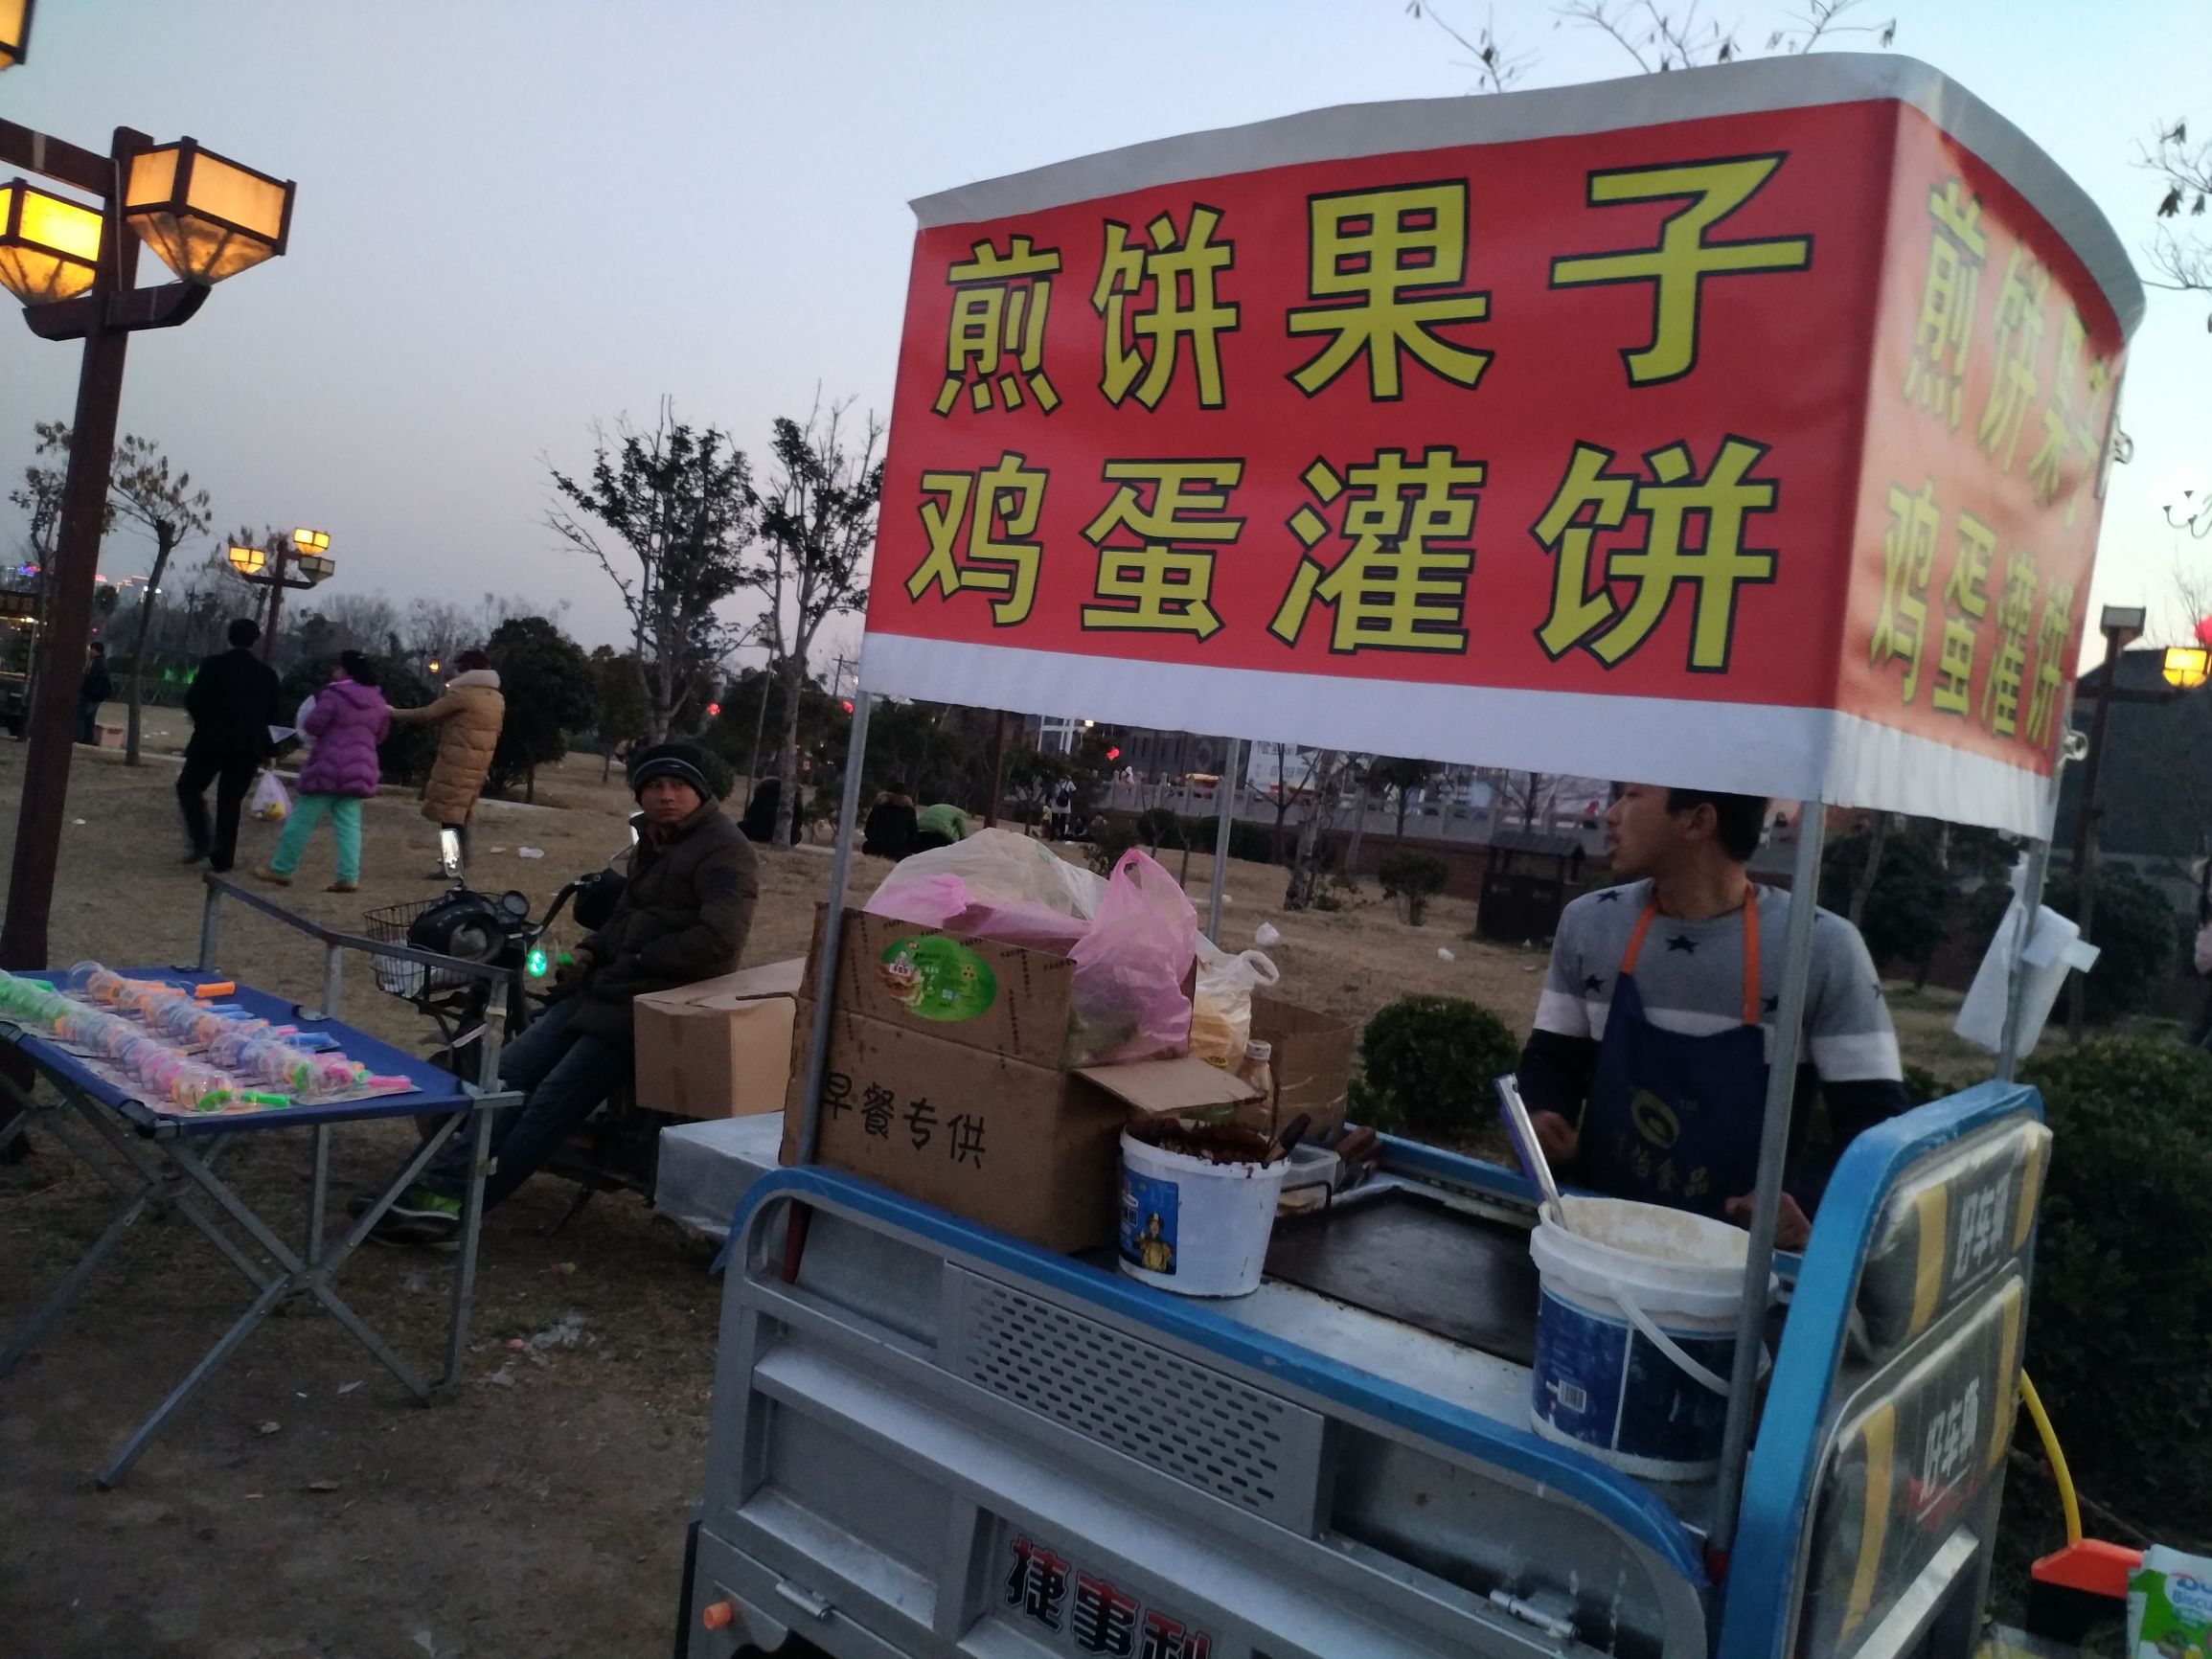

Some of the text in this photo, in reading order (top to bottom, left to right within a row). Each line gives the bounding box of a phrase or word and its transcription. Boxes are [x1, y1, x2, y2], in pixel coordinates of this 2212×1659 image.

[933, 149, 1813, 418] 煎饼果子
[905, 434, 1779, 674] 鸡蛋灌饼
[1868, 473, 2075, 755] 鸡蛋灌饼
[824, 1071, 988, 1170] 早餐专供
